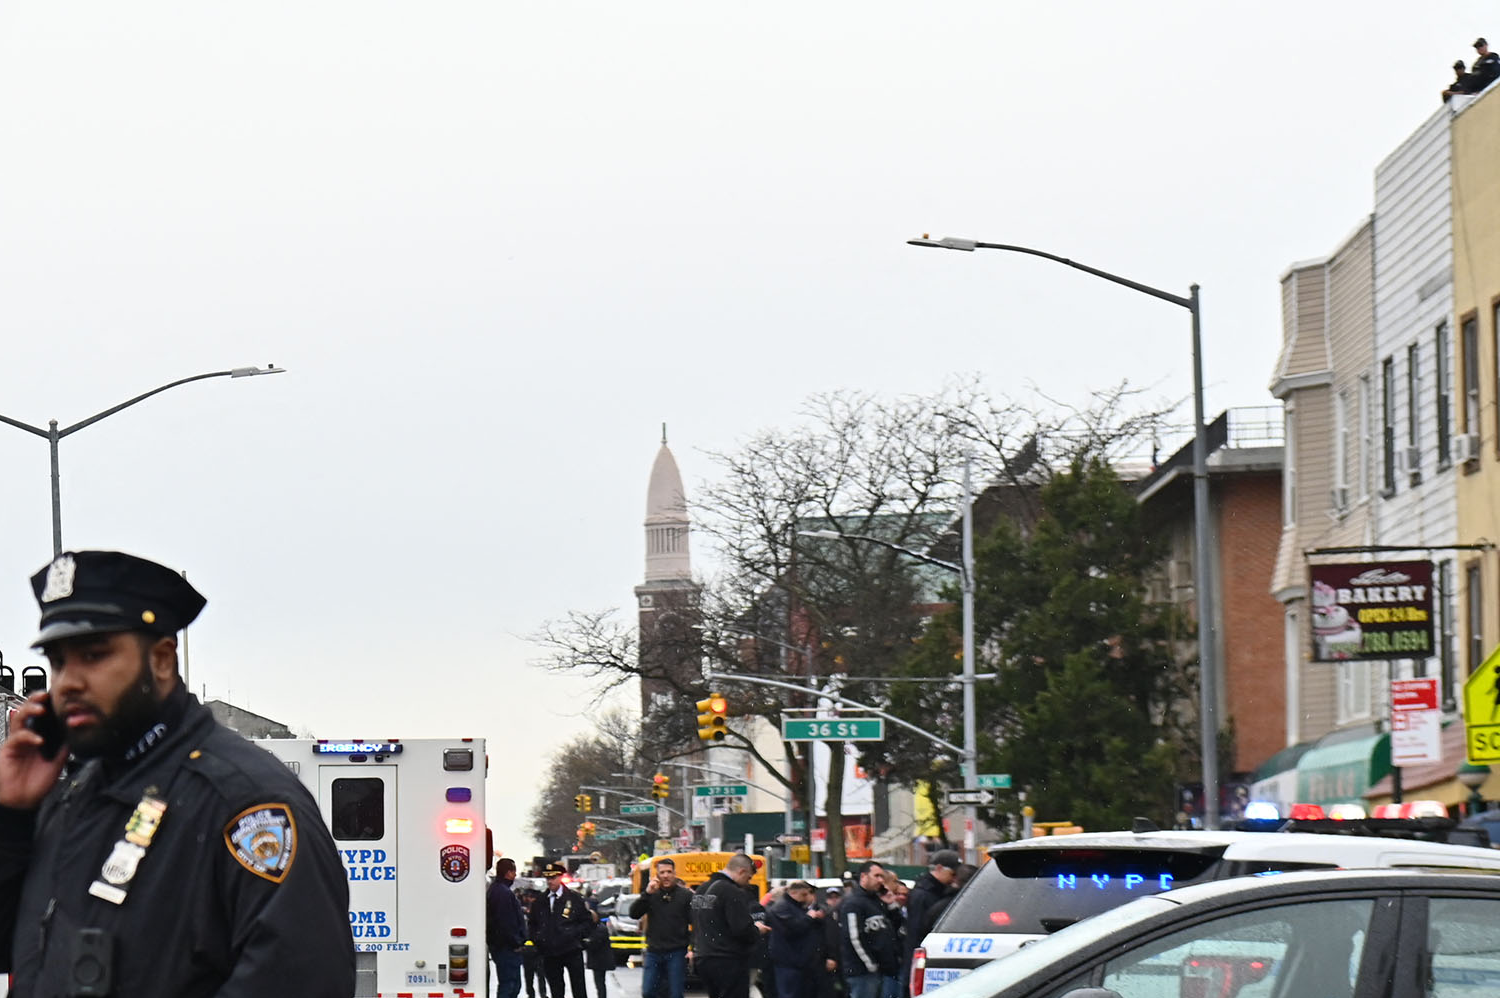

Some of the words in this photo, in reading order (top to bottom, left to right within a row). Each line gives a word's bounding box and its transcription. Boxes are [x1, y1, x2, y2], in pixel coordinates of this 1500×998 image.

[1337, 585, 1426, 604] BAKERY
[807, 723, 831, 737] 36
[836, 723, 859, 737] St
[1475, 731, 1500, 752] SC
[441, 846, 469, 857] POLICE
[346, 866, 396, 881] LICE
[685, 862, 713, 873] SCHOOL
[366, 943, 383, 951] 200
[387, 943, 410, 951] FEET
[944, 938, 994, 953] NYPD
[407, 975, 428, 983] 7091
